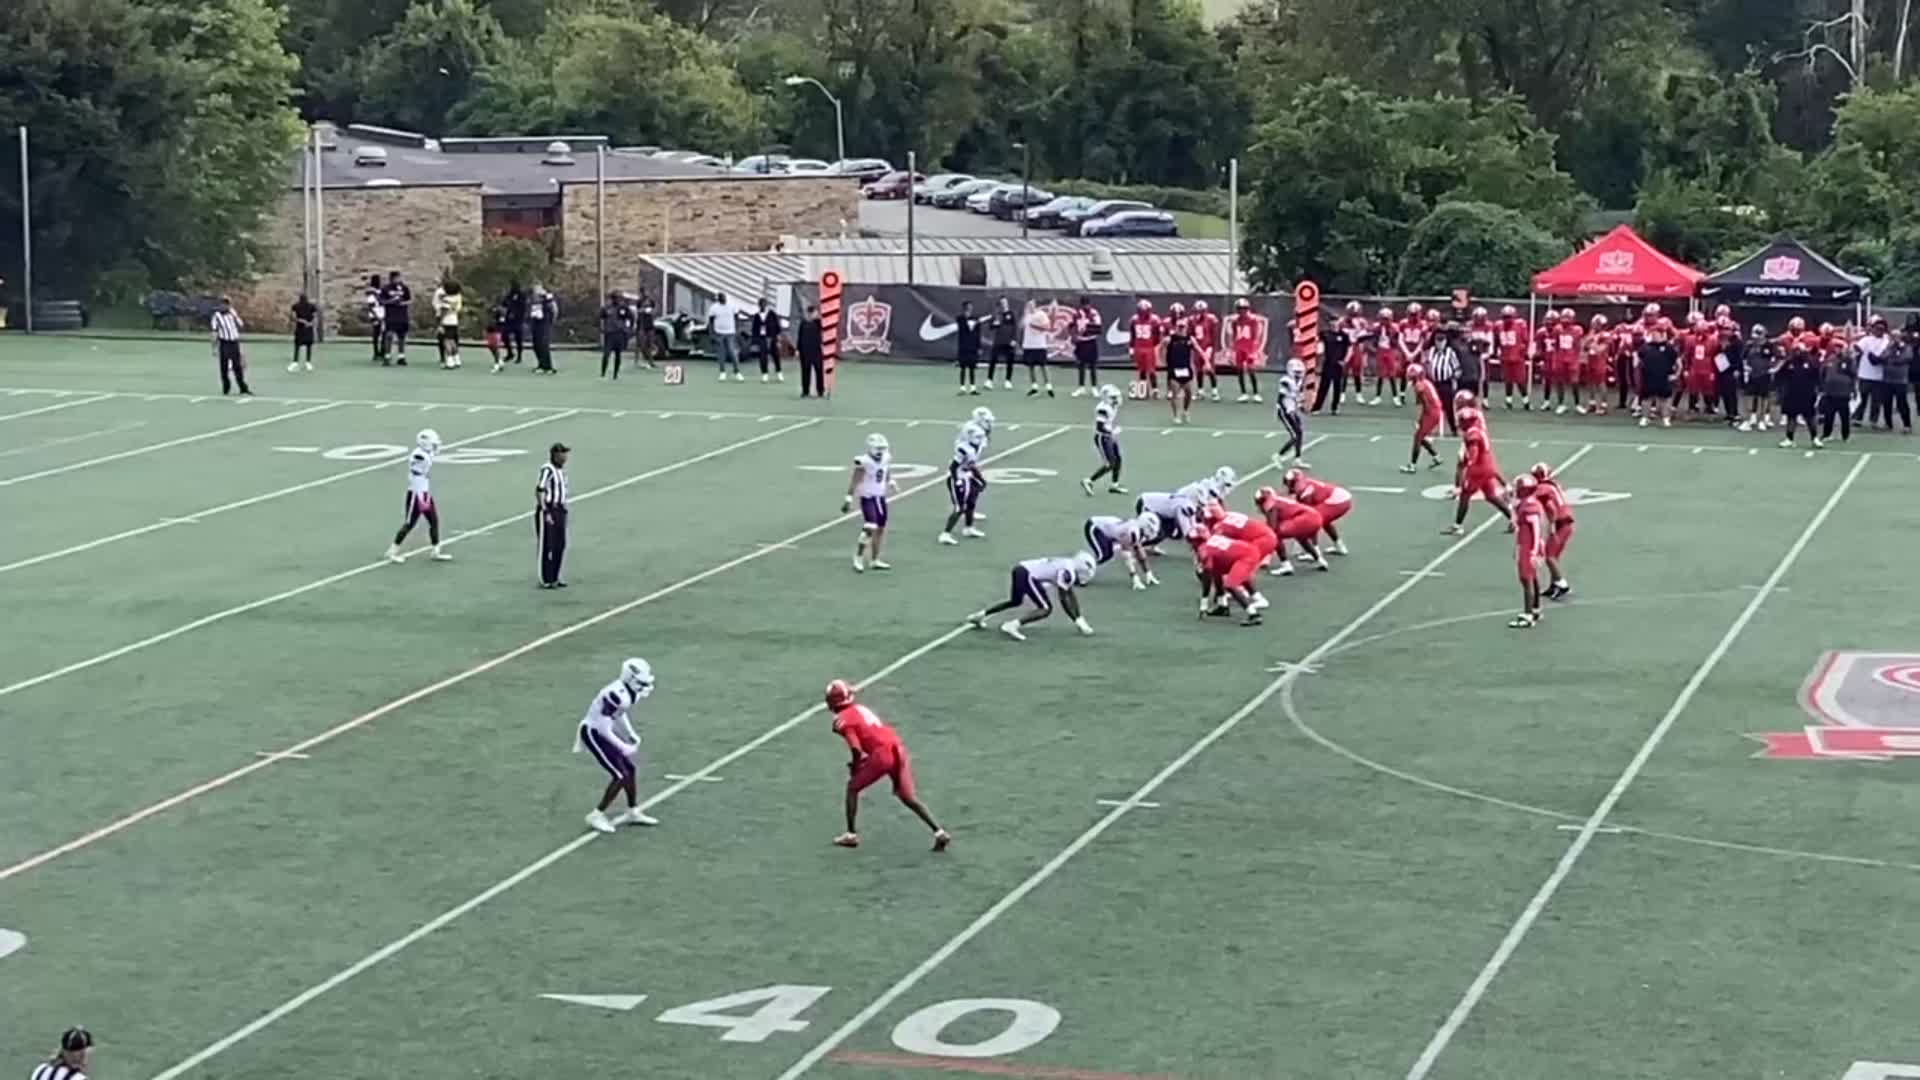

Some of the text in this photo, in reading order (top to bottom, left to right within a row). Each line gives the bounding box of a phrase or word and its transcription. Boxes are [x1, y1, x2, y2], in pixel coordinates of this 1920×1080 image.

[1577, 283, 1645, 292] ATHLETICS
[1744, 287, 1811, 296] FOOTBALL
[664, 366, 682, 383] 20
[1128, 381, 1147, 398] 30
[655, 984, 1062, 1058] 40
